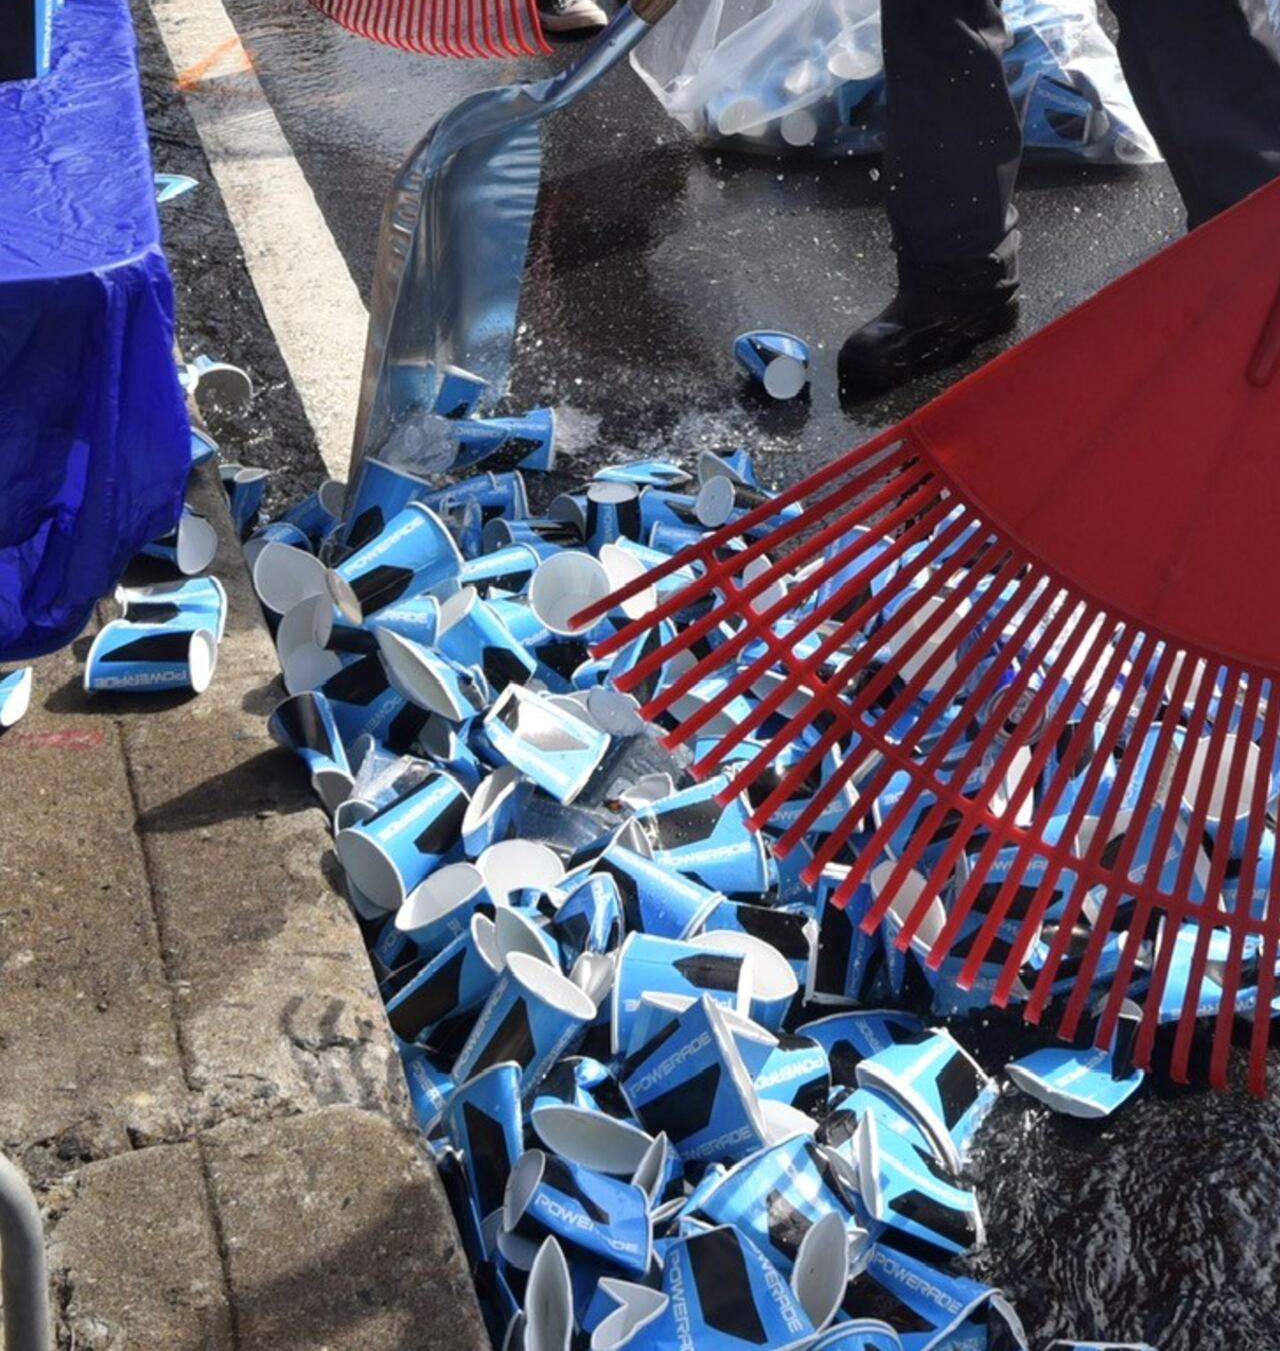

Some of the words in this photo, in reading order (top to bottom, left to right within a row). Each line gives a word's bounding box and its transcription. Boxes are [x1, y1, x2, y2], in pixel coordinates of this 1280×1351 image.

[95, 671, 187, 689] POWERADE
[628, 1030, 713, 1099] POWERADE
[872, 1250, 964, 1315] POWERADE
